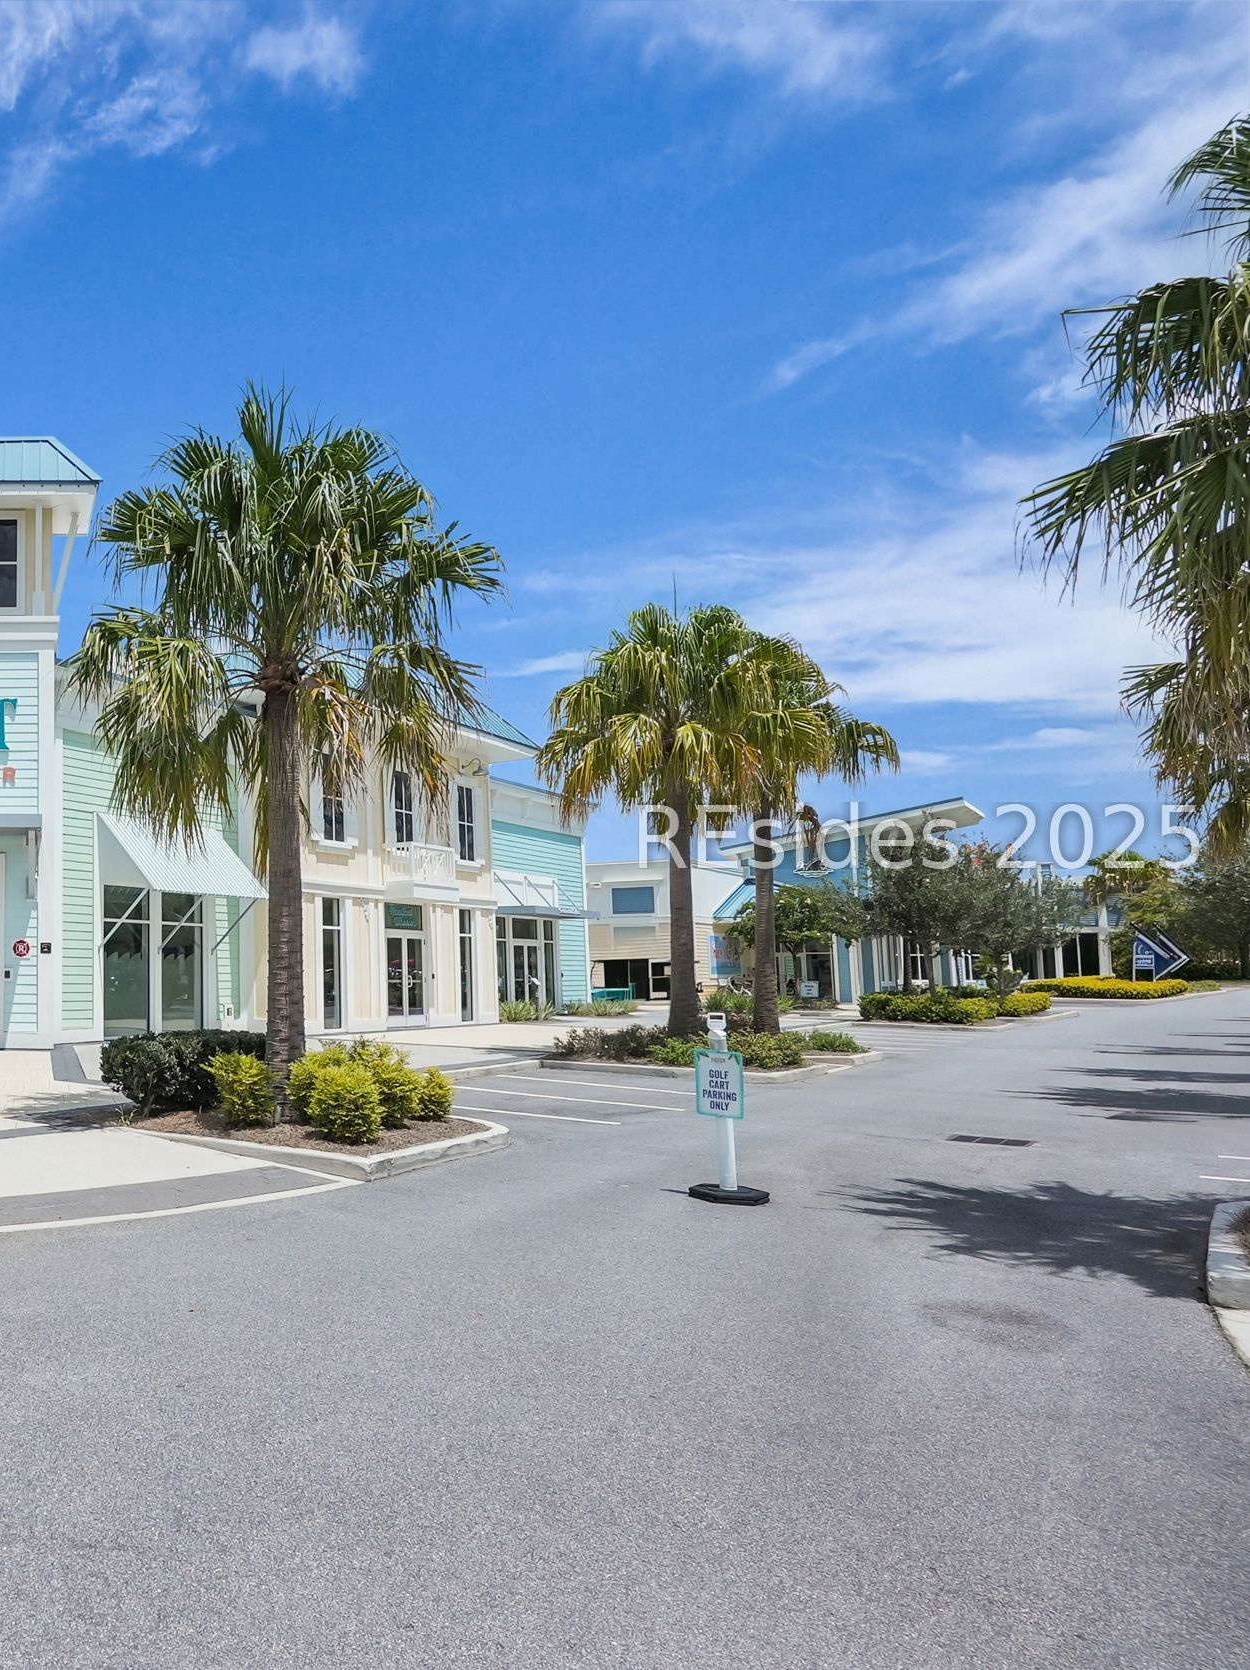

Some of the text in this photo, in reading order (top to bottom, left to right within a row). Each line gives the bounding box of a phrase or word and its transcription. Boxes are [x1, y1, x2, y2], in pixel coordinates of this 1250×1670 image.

[709, 1069, 729, 1080] GOLF
[709, 1079, 730, 1090] CART
[702, 1089, 737, 1102] PARKING
[710, 1100, 730, 1111] ONLY
